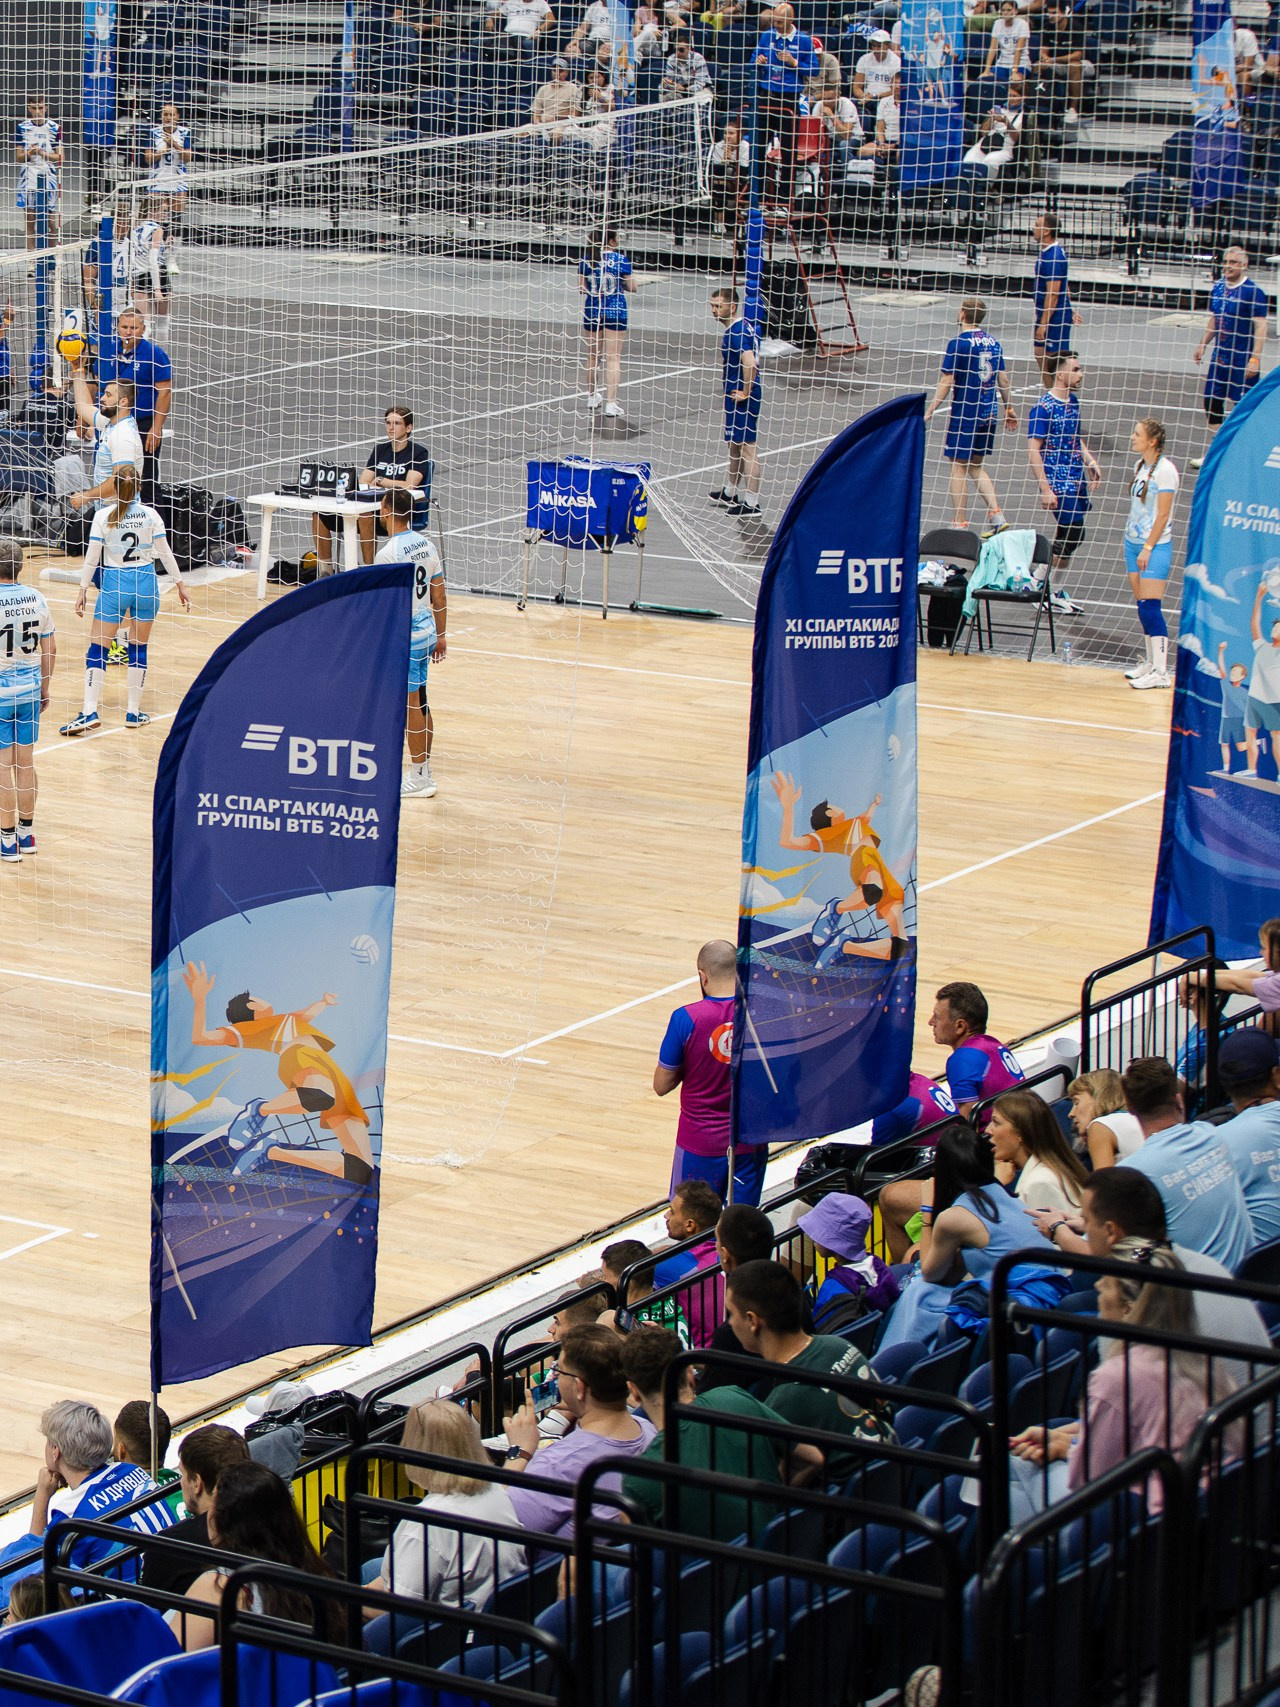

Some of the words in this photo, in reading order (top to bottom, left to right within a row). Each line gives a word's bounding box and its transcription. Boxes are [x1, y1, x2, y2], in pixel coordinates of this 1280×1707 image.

[968, 336, 997, 347] УРФО
[978, 351, 993, 382] 5
[300, 469, 312, 485] 5
[385, 465, 407, 476] ВТБ
[1131, 480, 1146, 498] 12
[1224, 499, 1243, 514] XI
[120, 532, 140, 562] 2
[415, 565, 428, 600] 8
[847, 557, 904, 594] ВТБ
[5, 607, 36, 618] ВОСТОК
[785, 618, 803, 632] XI
[0, 620, 40, 658] 15
[785, 636, 846, 649] ГРУППЫ
[849, 635, 876, 648] ВТБ
[288, 736, 378, 781] ВТБ
[197, 793, 219, 808] XI
[225, 794, 380, 823] СПАРТАКИАДА
[197, 811, 281, 831] ГРУППЫ
[286, 818, 325, 834] ВТБ
[329, 822, 380, 840] 2024
